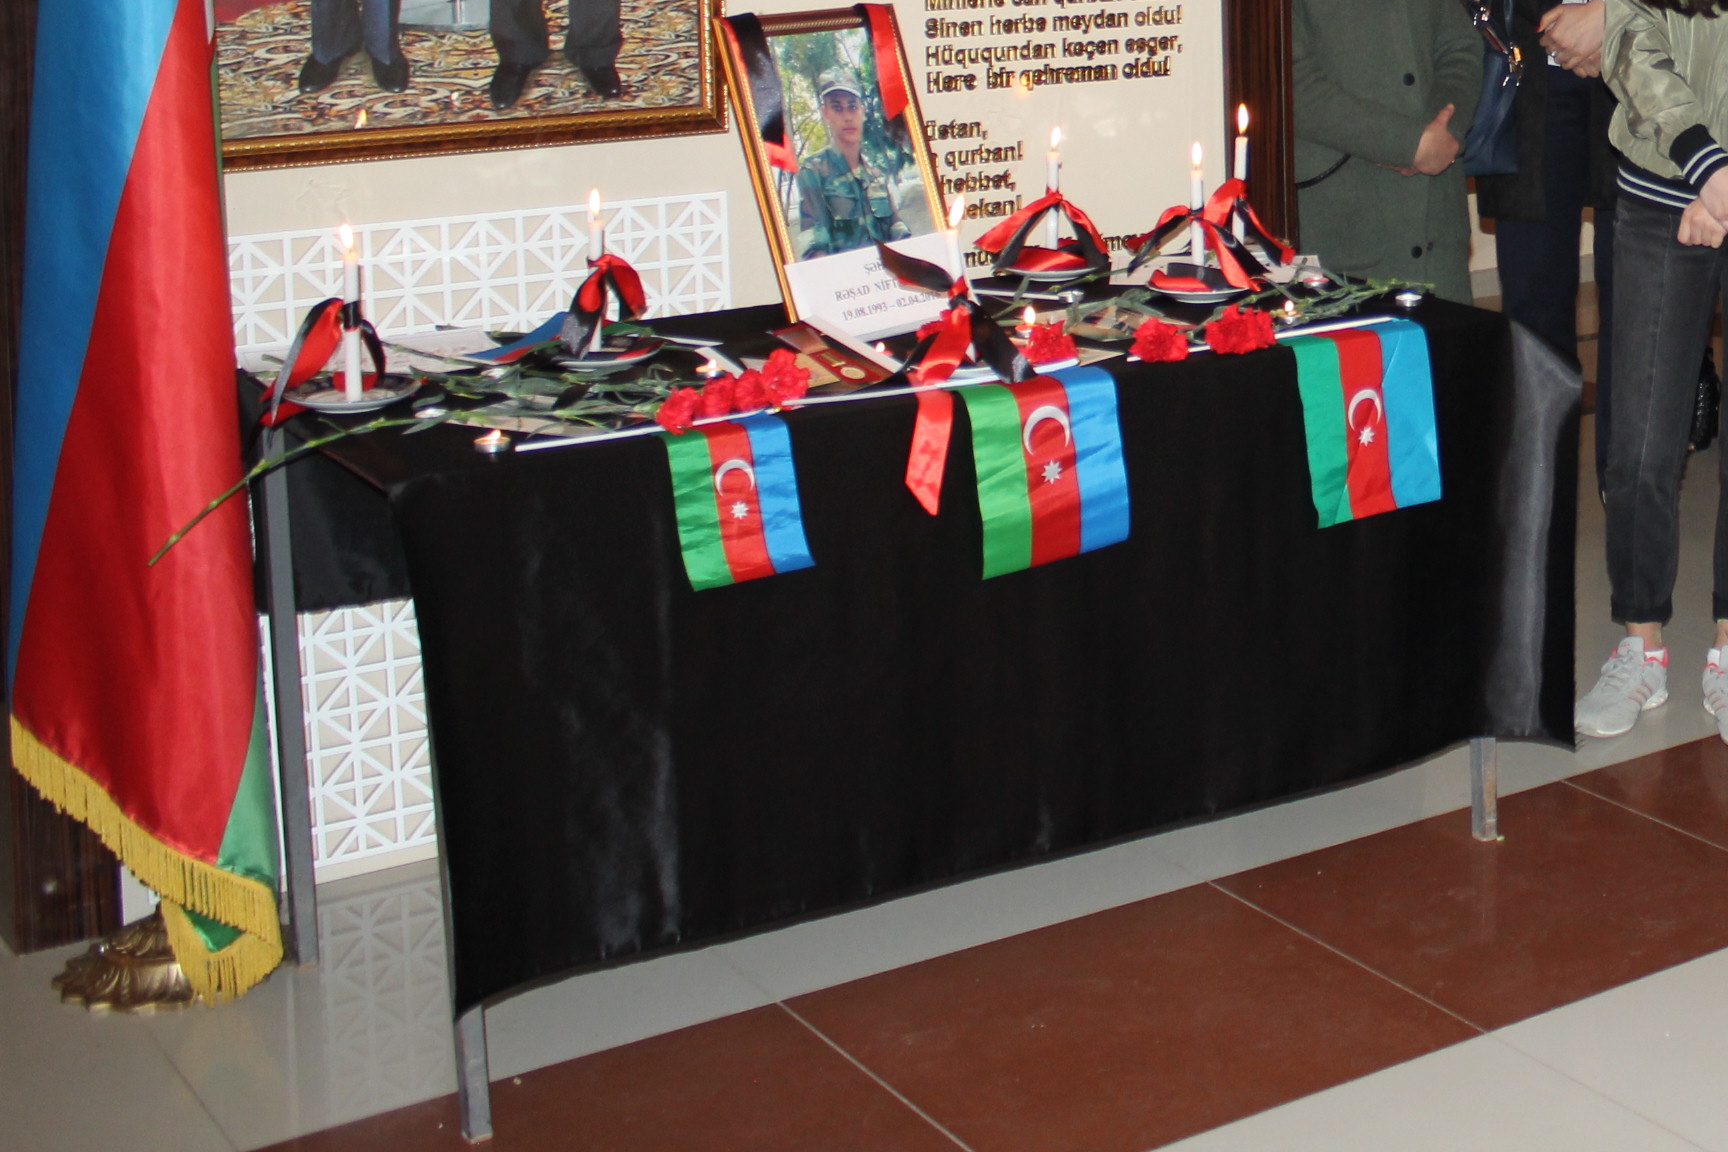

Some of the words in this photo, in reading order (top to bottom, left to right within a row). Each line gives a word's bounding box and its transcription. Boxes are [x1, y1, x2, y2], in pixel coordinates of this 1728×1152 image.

[1134, 5, 1183, 26] oldu!
[986, 67, 1016, 90] bir
[1122, 56, 1171, 79] oldu!
[924, 119, 988, 141] üstan,
[944, 140, 1024, 170] qurban!
[939, 169, 1017, 195] həbbət,
[835, 285, 870, 301] RƏŞAD
[874, 278, 898, 291] NİFT
[842, 302, 888, 321] 19.08.1993
